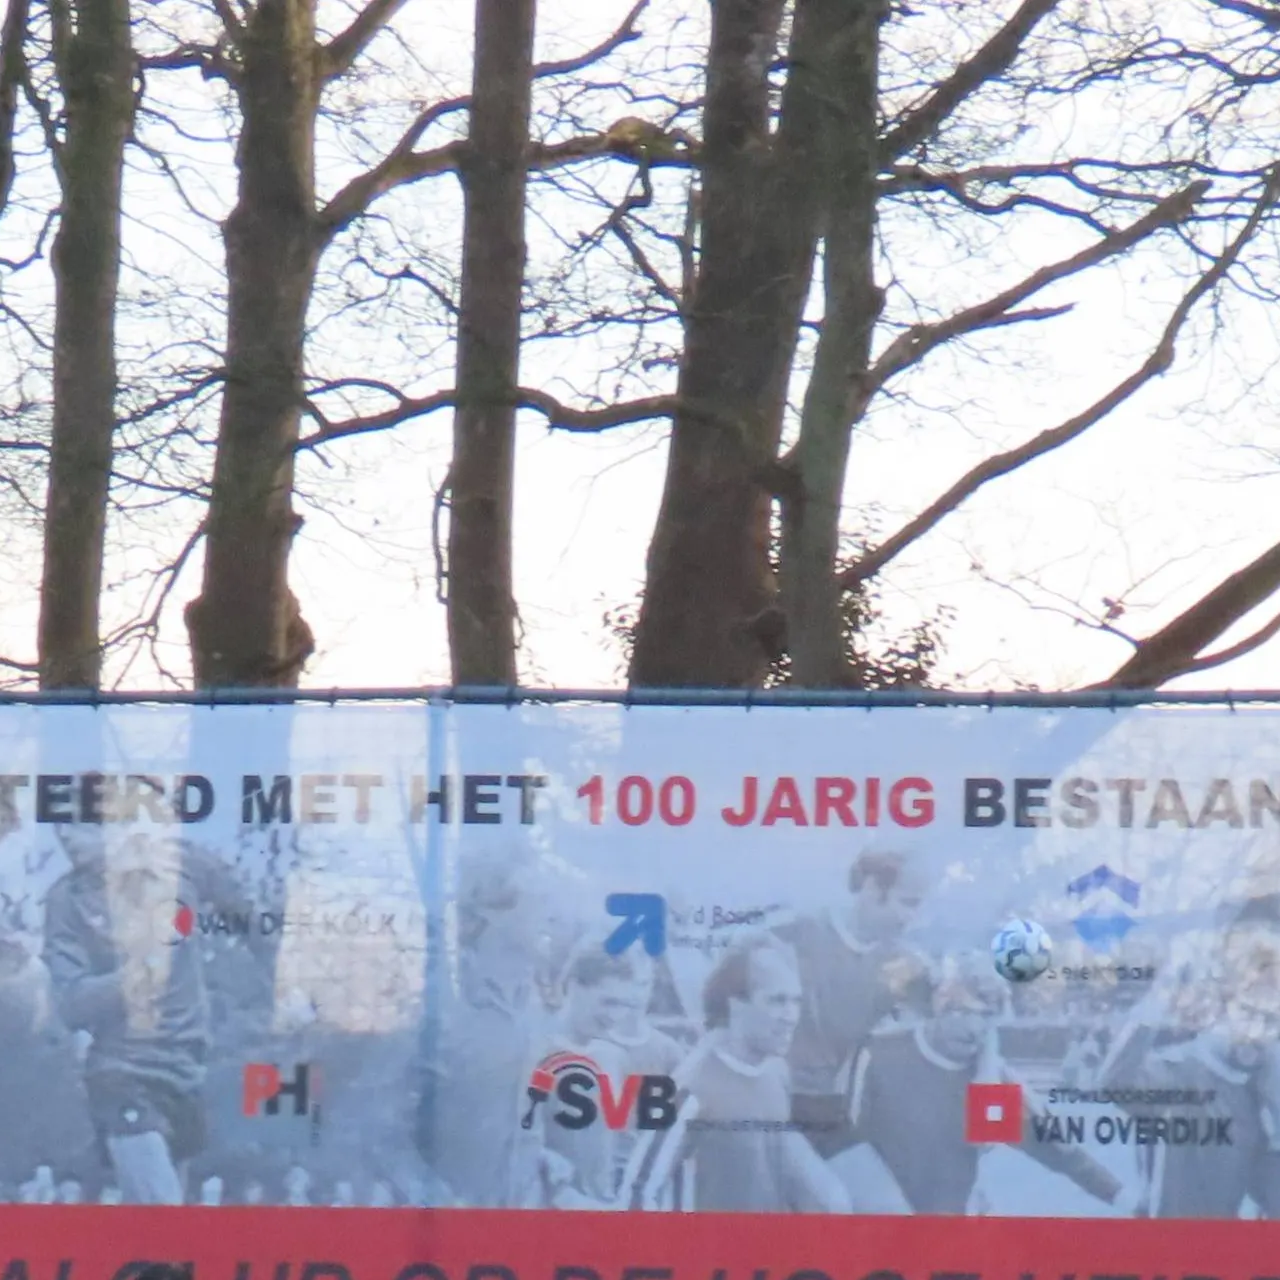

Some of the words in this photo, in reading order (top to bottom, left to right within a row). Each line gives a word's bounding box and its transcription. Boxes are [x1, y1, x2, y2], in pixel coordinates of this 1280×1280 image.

[241, 774, 384, 825] MET
[409, 774, 548, 826] HET
[576, 775, 696, 827] 100
[721, 776, 935, 828] JARIG
[197, 911, 251, 935] VAN
[553, 1071, 678, 1131] SVB
[1031, 1115, 1085, 1145] VAN
[1094, 1115, 1234, 1147] OVERDIJK
